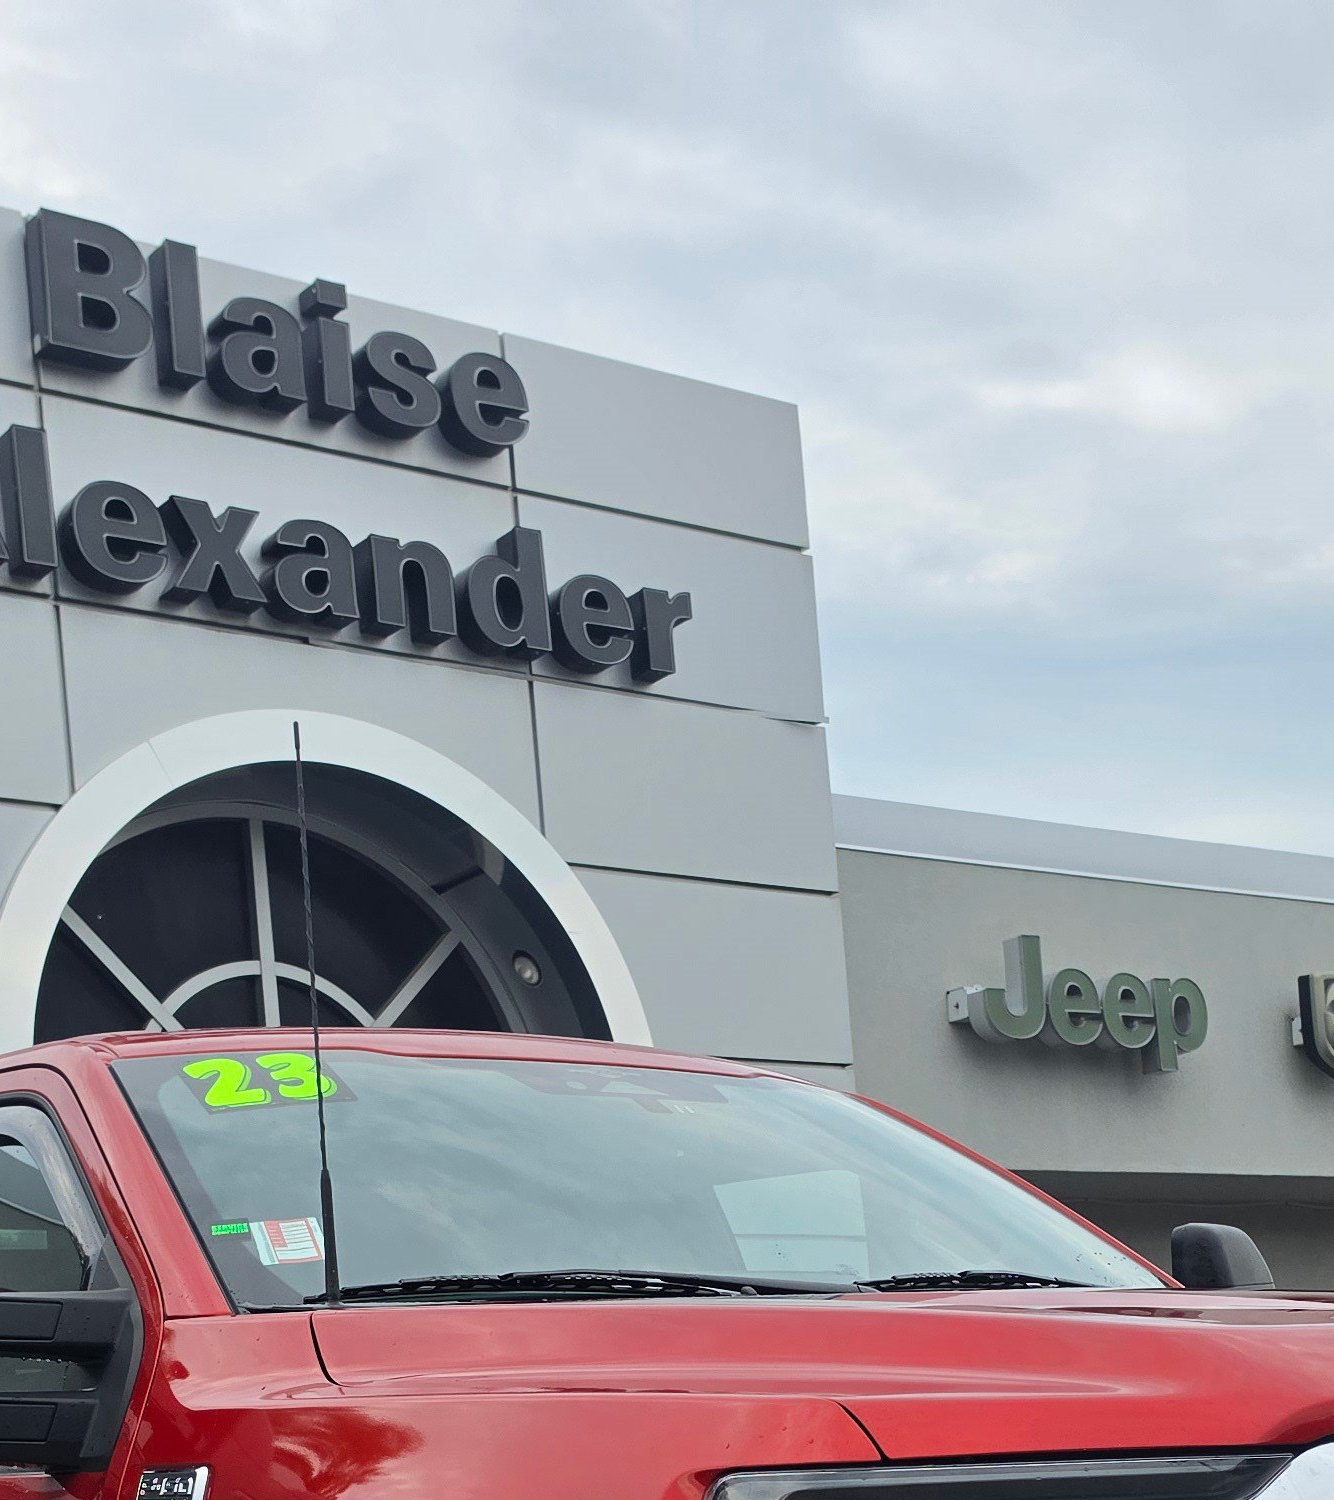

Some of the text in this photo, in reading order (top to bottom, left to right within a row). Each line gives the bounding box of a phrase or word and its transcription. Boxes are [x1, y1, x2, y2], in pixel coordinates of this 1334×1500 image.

[25, 207, 530, 458] Blaise
[968, 934, 1208, 1075] Jeep
[182, 1053, 338, 1107] 23
